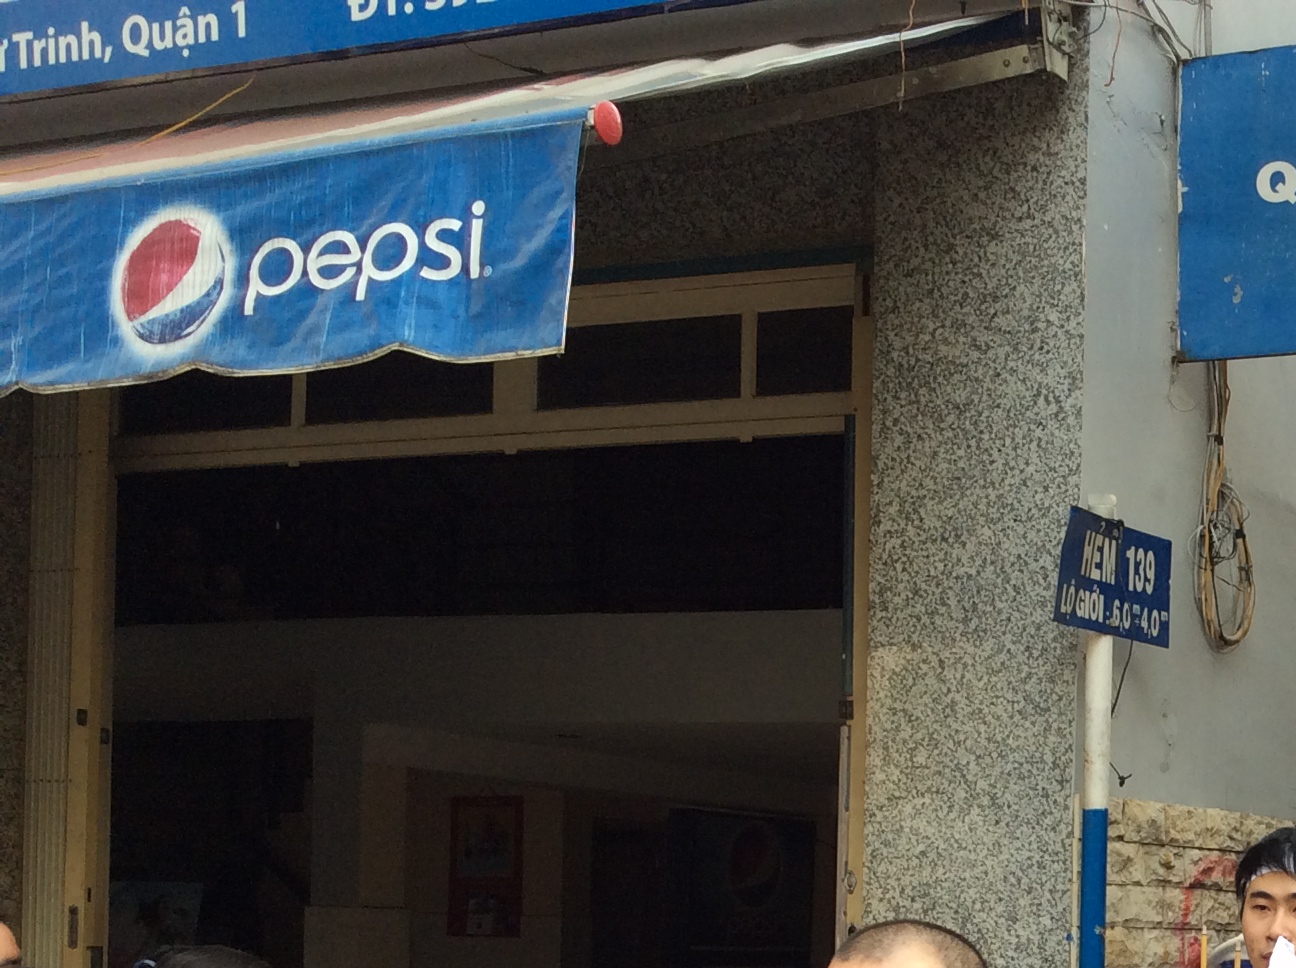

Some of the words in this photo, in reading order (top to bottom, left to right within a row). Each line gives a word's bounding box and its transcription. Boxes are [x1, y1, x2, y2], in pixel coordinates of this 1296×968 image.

[12, 20, 113, 70] Trinh,
[122, 5, 219, 58] Quận
[230, 0, 246, 38] 1
[243, 199, 487, 316] pepsi
[1125, 545, 1156, 595] 139
